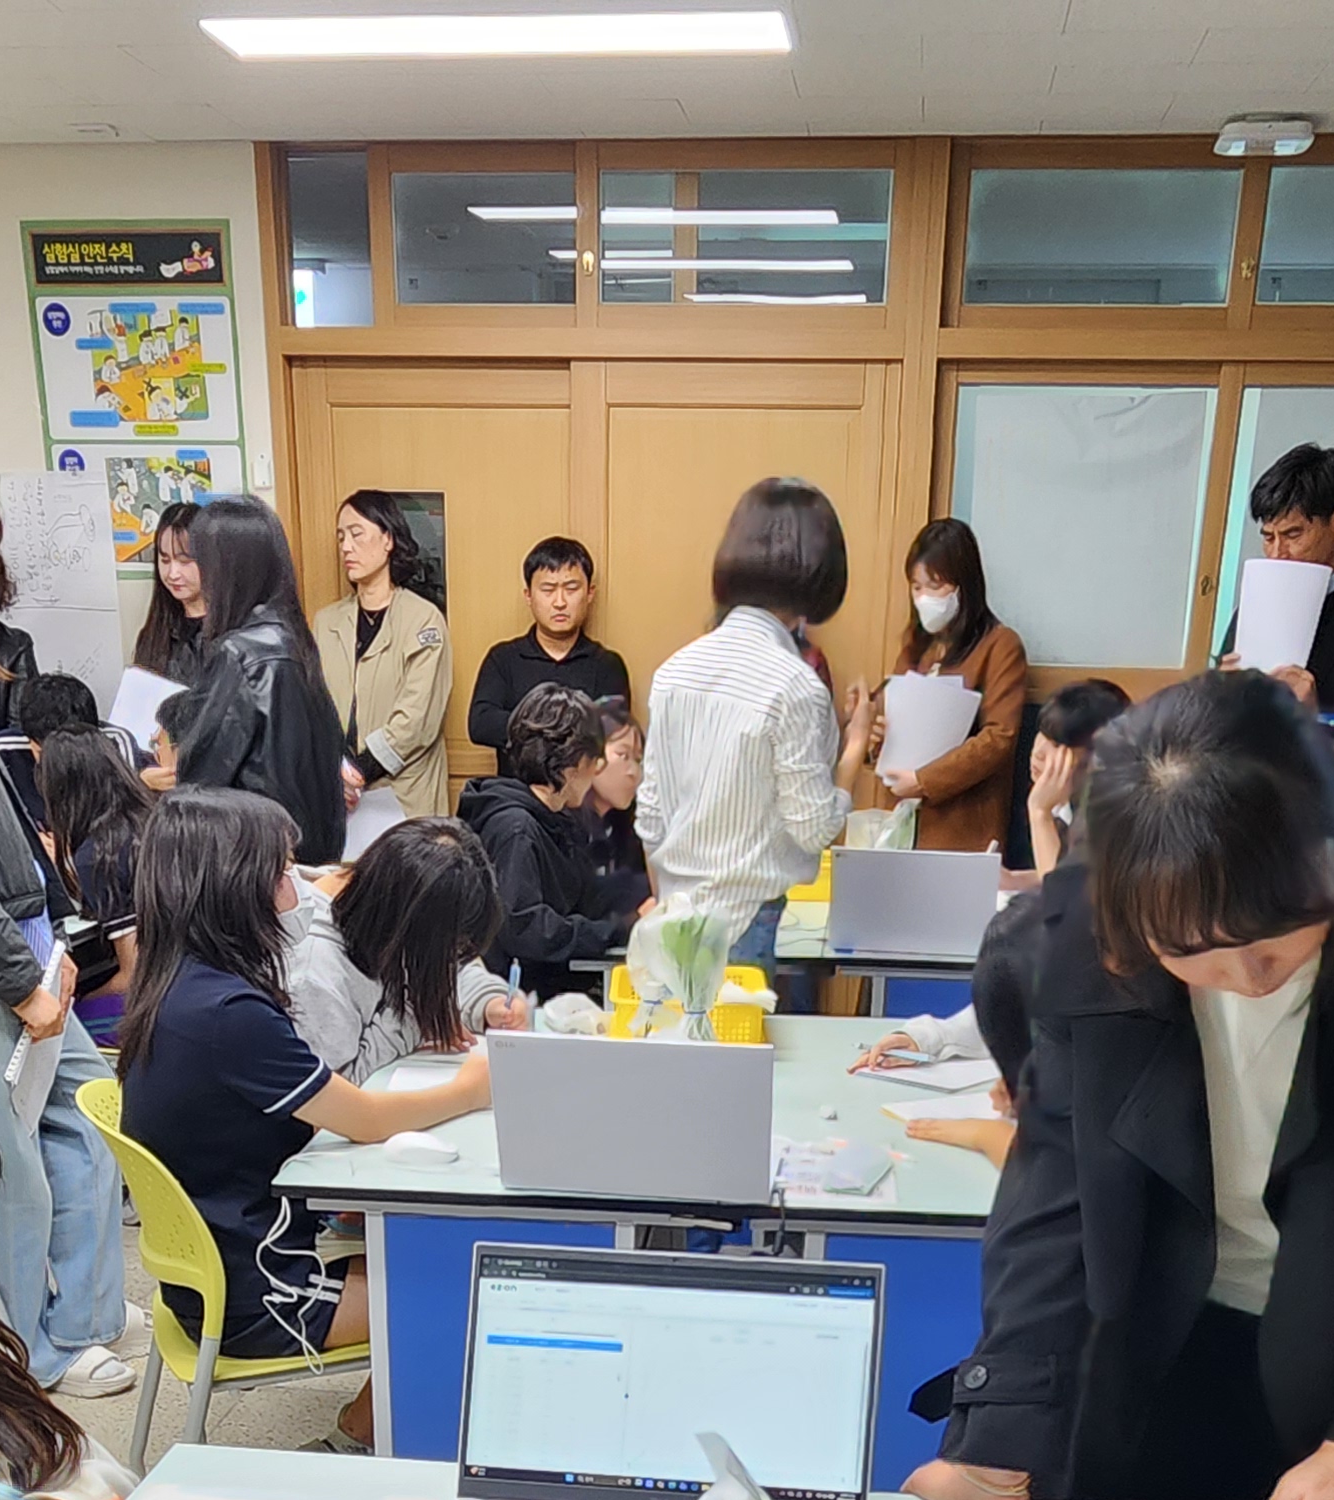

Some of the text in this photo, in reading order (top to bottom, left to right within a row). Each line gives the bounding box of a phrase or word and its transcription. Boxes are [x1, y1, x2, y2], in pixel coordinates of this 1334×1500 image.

[42, 242, 134, 263] 실험실 안전 수칙
